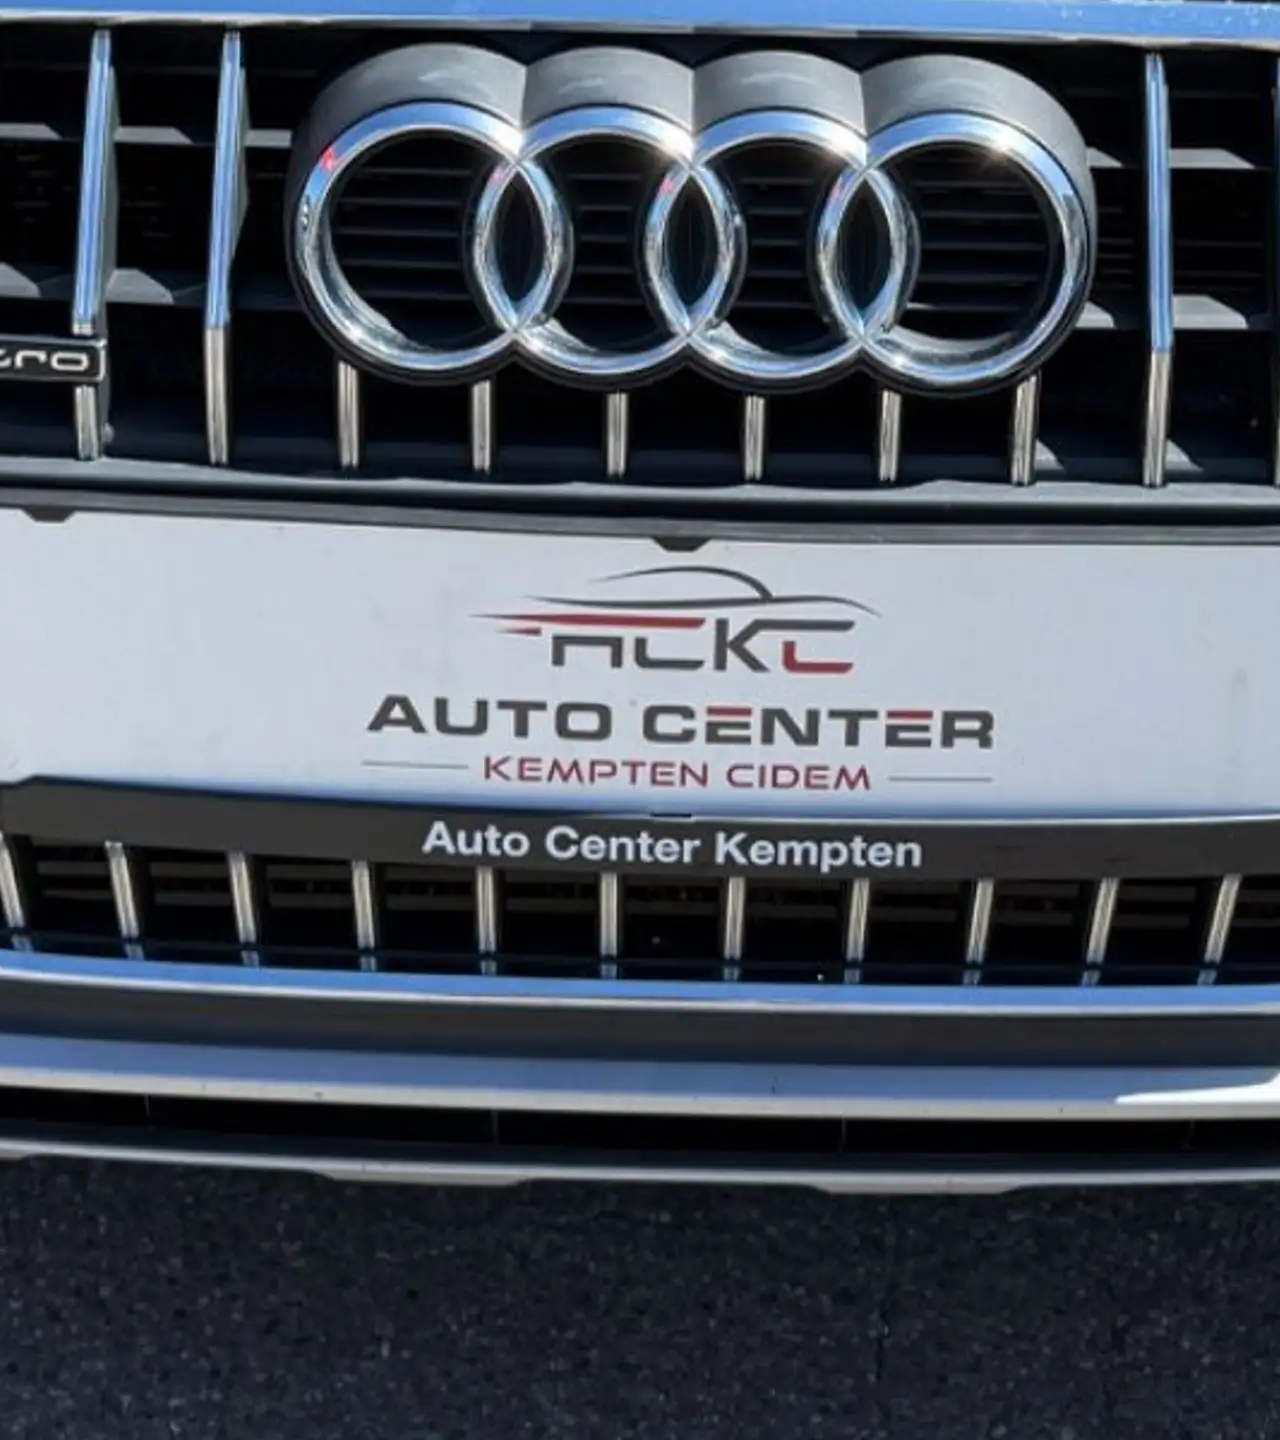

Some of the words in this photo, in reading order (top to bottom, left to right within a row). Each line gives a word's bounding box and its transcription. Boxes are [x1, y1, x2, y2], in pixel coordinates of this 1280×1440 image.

[366, 694, 613, 740] AUTO
[642, 704, 994, 749] CENTER
[483, 755, 709, 788] KEMPTEN
[725, 762, 871, 791] CIDEM
[422, 820, 531, 858] Auto
[544, 825, 701, 864] Center
[715, 830, 922, 872] Kempten
